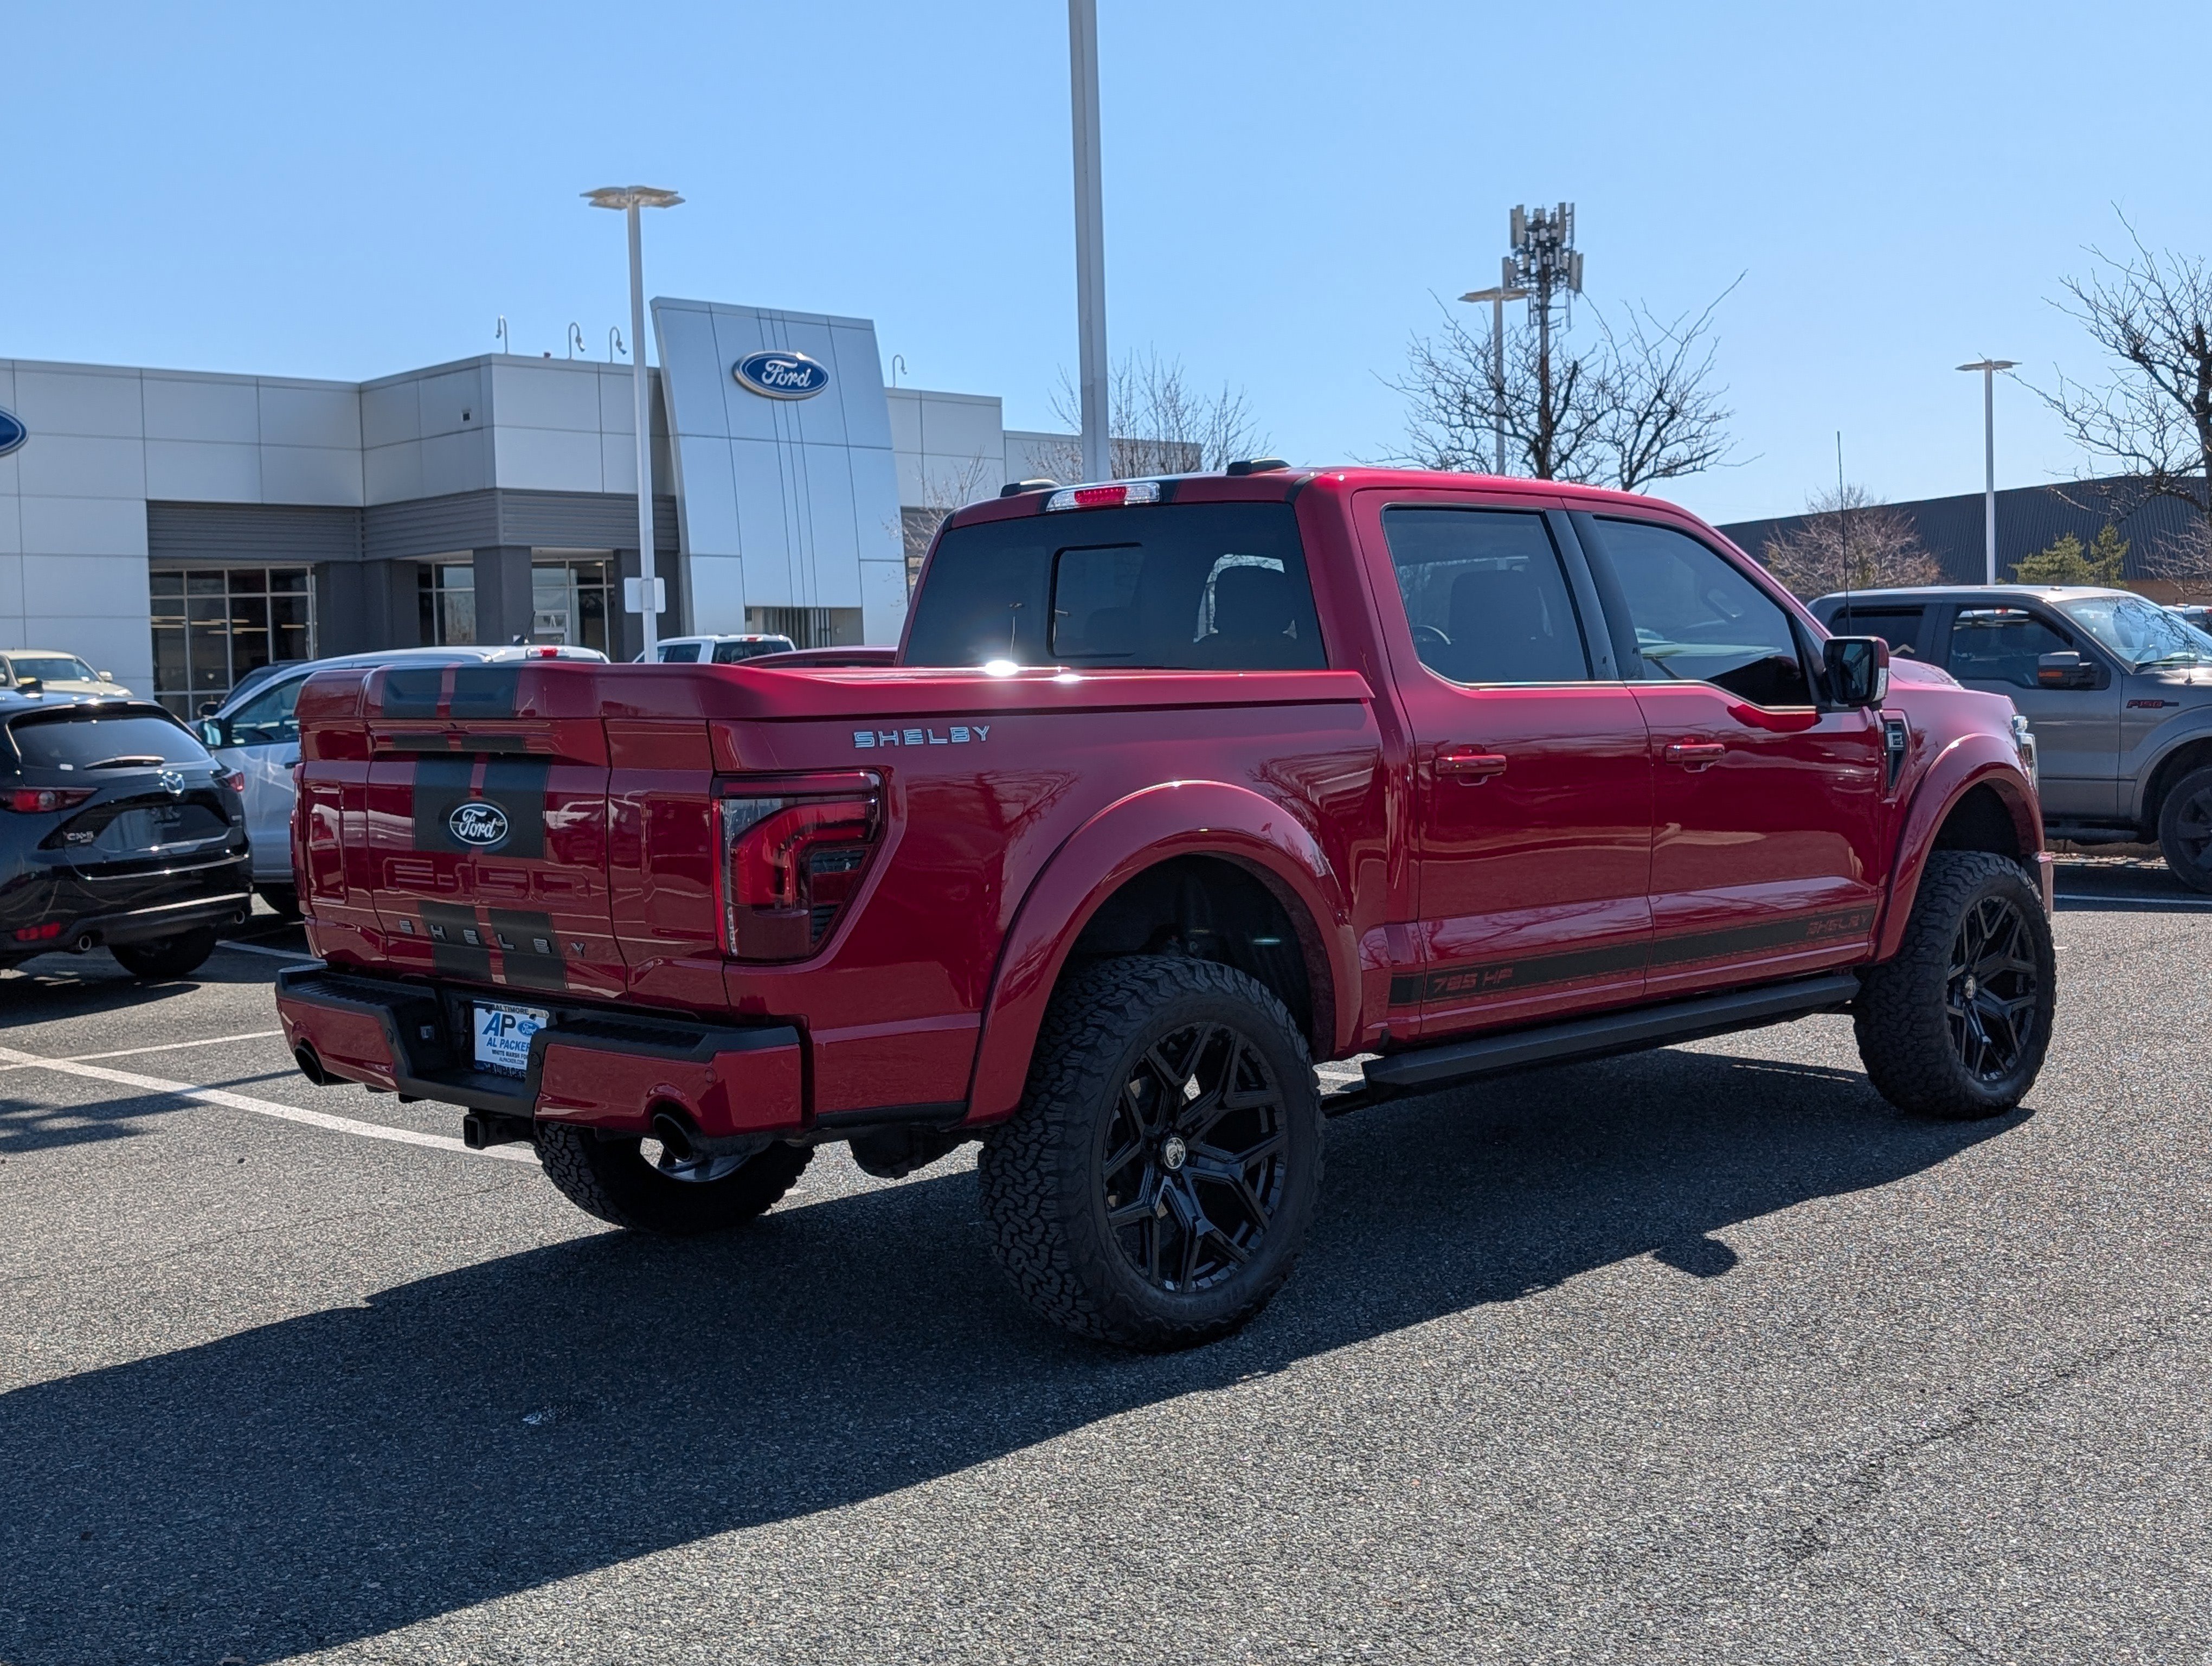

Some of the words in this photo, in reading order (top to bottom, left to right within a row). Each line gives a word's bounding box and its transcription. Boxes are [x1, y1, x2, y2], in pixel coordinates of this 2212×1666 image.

[761, 360, 812, 387] Ford
[853, 725, 989, 748] SHELBY
[458, 808, 496, 838] Ford
[67, 831, 94, 841] CX-5
[1806, 914, 1870, 935] SHELBY
[399, 919, 586, 957] SHELBY
[1482, 967, 1513, 986] HP
[492, 1004, 530, 1015] BALTIMORE
[482, 1013, 516, 1037] AP
[486, 1036, 497, 1047] AL
